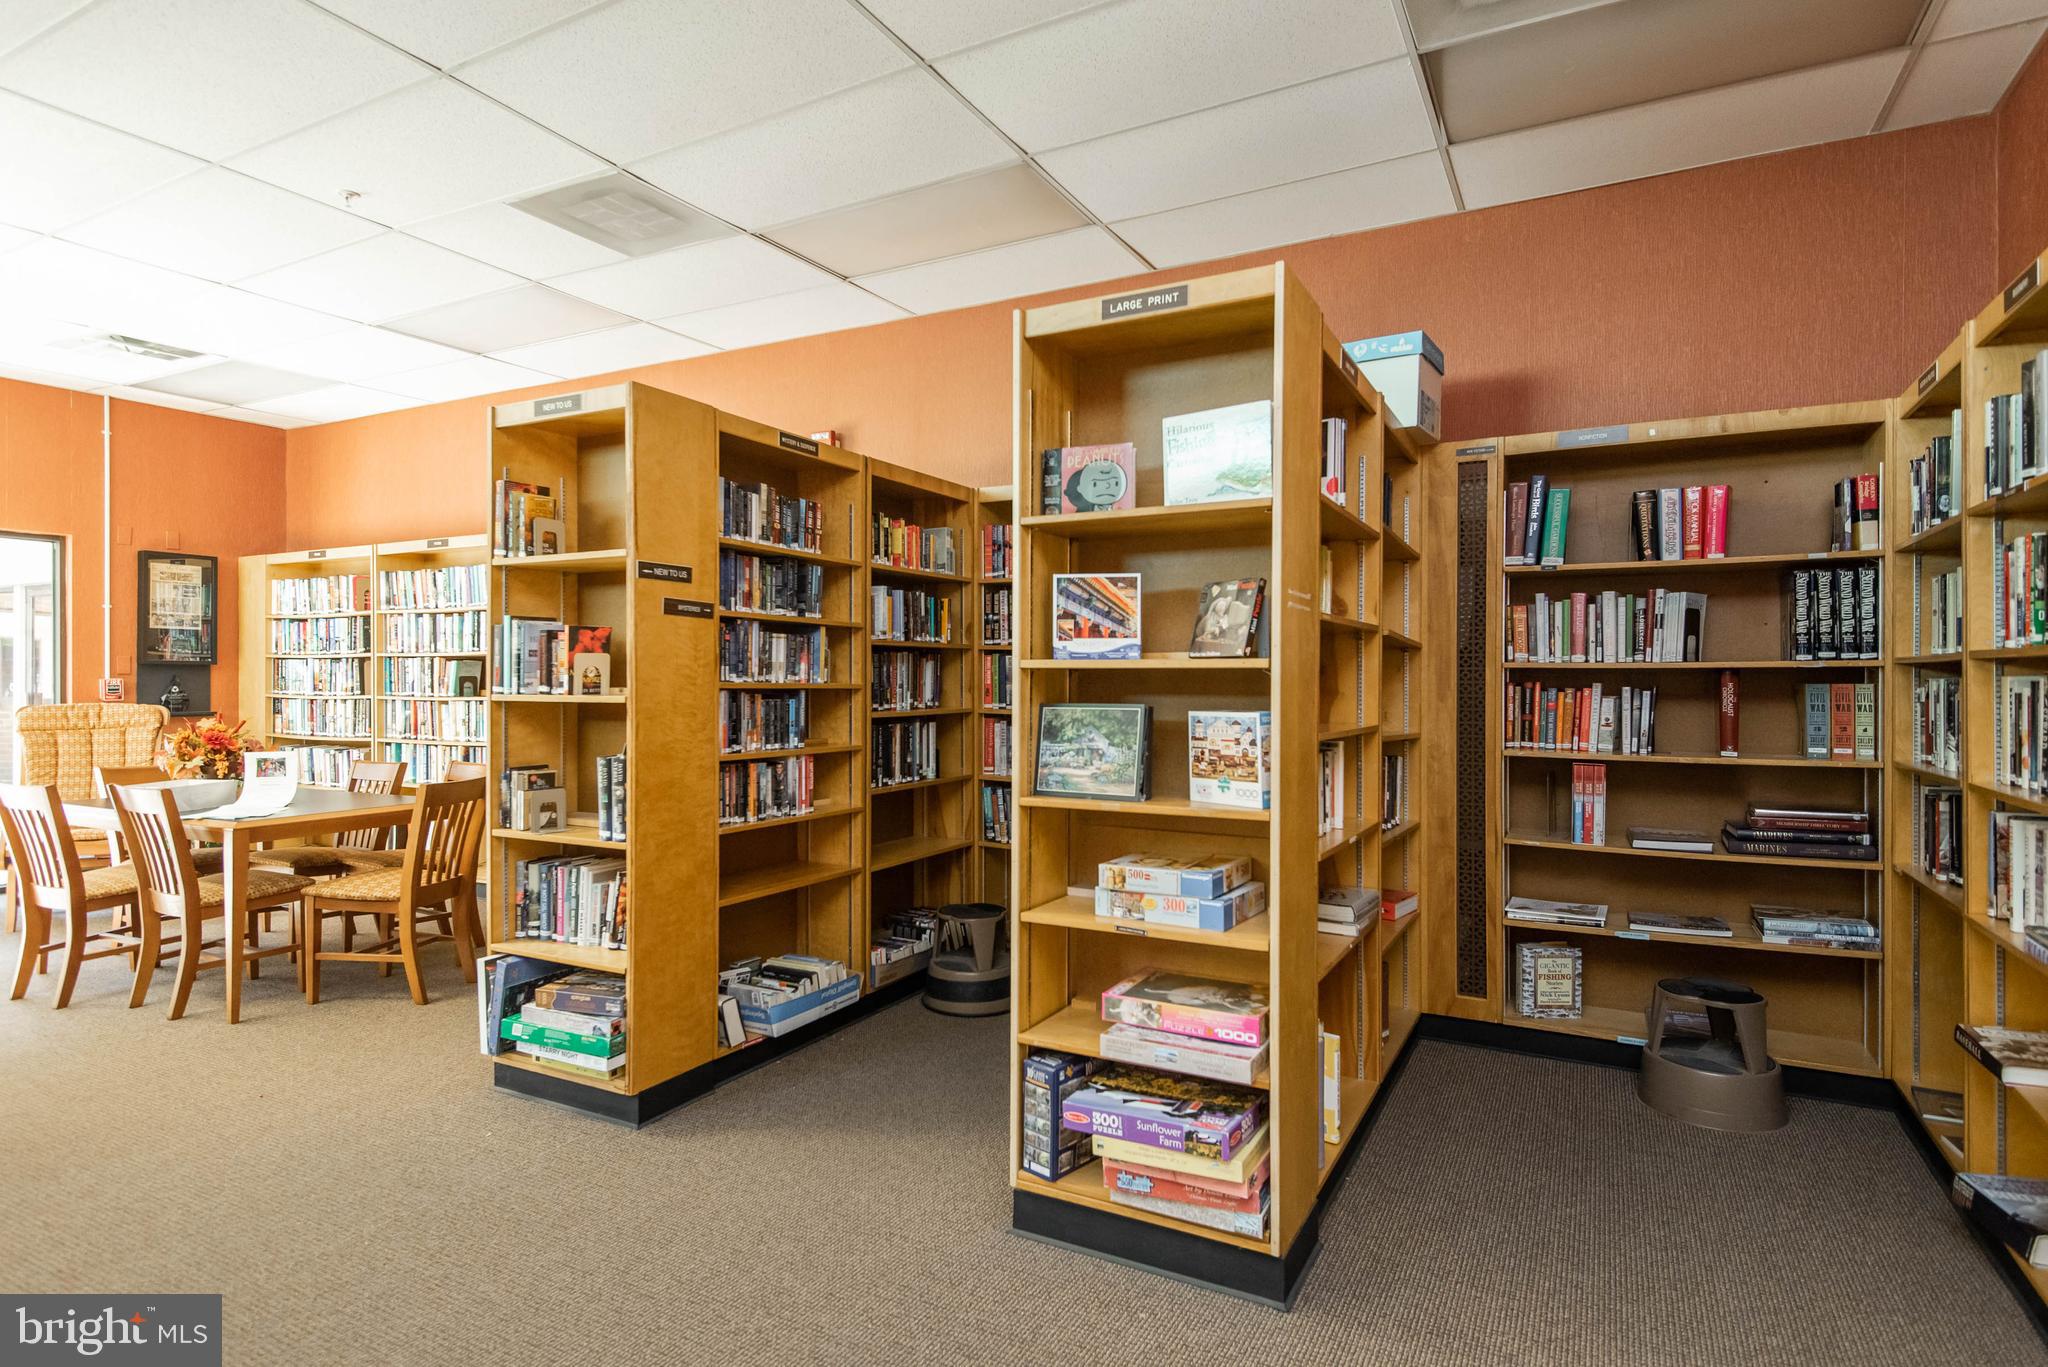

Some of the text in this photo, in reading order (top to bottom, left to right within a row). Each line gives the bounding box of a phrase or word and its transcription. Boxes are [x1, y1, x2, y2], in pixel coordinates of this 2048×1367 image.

[1109, 291, 1180, 314] LARGE PRINT
[1167, 422, 1215, 437] Hilarious
[1067, 452, 1125, 468] PEANUTS
[1530, 498, 1541, 519] Birds
[1639, 502, 1649, 548] QUOTATIONS
[654, 567, 688, 578] NEW TO US
[1796, 577, 1809, 599] SECOND
[1818, 576, 1832, 599] SECOND
[1841, 575, 1854, 598] SECOND
[1861, 575, 1875, 598] SECOND
[1796, 599, 1809, 620] WORLD
[1819, 598, 1832, 620] WORLD
[1841, 598, 1854, 619] WORLD
[1861, 597, 1875, 618] WORLD
[1796, 620, 1809, 634] WAR
[1819, 619, 1832, 633] WAR
[1841, 619, 1855, 633] WAR
[1862, 618, 1875, 632] WAR
[1809, 692, 1826, 703] CIVIL
[1856, 692, 1873, 703] CIVIL
[1809, 703, 1826, 713] WAR
[1856, 703, 1873, 713] WAR
[1755, 831, 1793, 840] MARINES
[1746, 843, 1788, 853] MARINES
[1127, 869, 1144, 880] 500
[1162, 896, 1186, 913] 300
[1814, 933, 1846, 941] CHURCHILL
[1214, 1028, 1258, 1044] 1000
[1136, 1119, 1182, 1138] Sunflower
[1159, 1135, 1182, 1149] Farm
